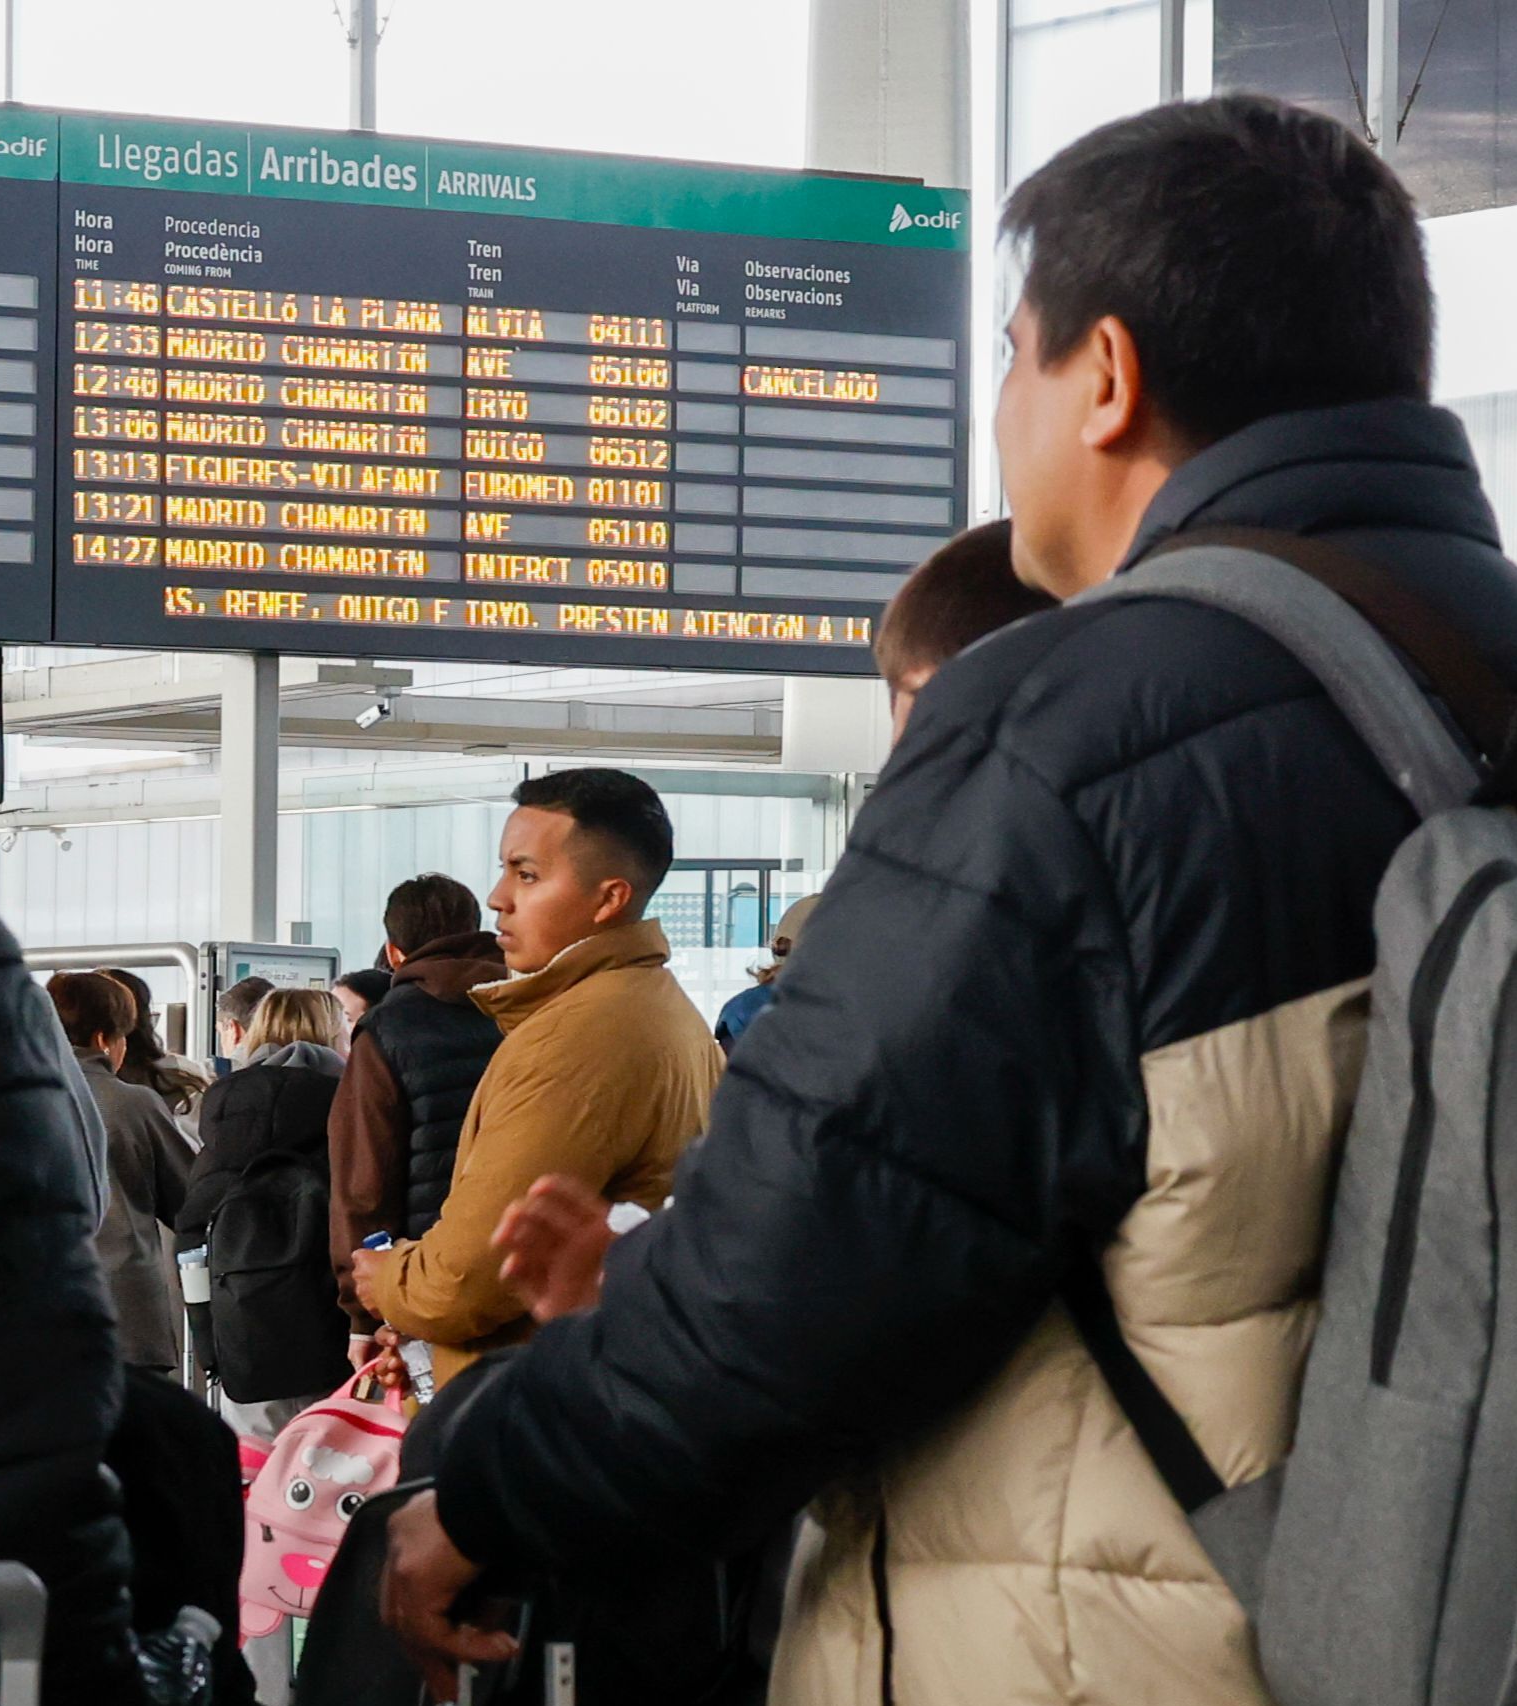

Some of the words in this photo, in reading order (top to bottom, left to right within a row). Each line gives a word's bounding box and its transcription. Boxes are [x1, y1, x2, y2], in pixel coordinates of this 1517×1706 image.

[100, 134, 237, 180] Llegadas
[261, 147, 416, 191] Arribades
[438, 171, 536, 200] ARRIVALS
[75, 210, 112, 229] Hora
[166, 216, 259, 238] Procedencia
[915, 211, 962, 229] adif
[76, 235, 112, 253] Hora
[166, 242, 262, 262] Procedència
[468, 240, 501, 258] Tren
[75, 259, 98, 270] TIME
[164, 264, 201, 276] COMING
[205, 266, 231, 278] FROM
[468, 264, 501, 281] Tren
[745, 261, 850, 283] Observaciones
[468, 287, 493, 298] TRAIN
[746, 284, 842, 305] Observacions
[74, 279, 158, 315] 11:46
[313, 296, 346, 327] LA
[360, 300, 442, 332] PLANA
[677, 302, 719, 314] PLATFORM
[745, 307, 785, 319] REMARKS
[167, 330, 262, 362] MADRID
[744, 368, 878, 402] CANCELADO
[166, 371, 265, 404] MADRID
[166, 414, 265, 445] MADRID
[75, 451, 157, 478] 13:13
[587, 481, 660, 509] 01101
[75, 493, 152, 524] 13:21
[166, 499, 265, 527] MADRID
[587, 520, 666, 546] 05110
[73, 535, 156, 565] 14:27
[166, 540, 264, 570] MADRID
[586, 560, 665, 588] 05910
